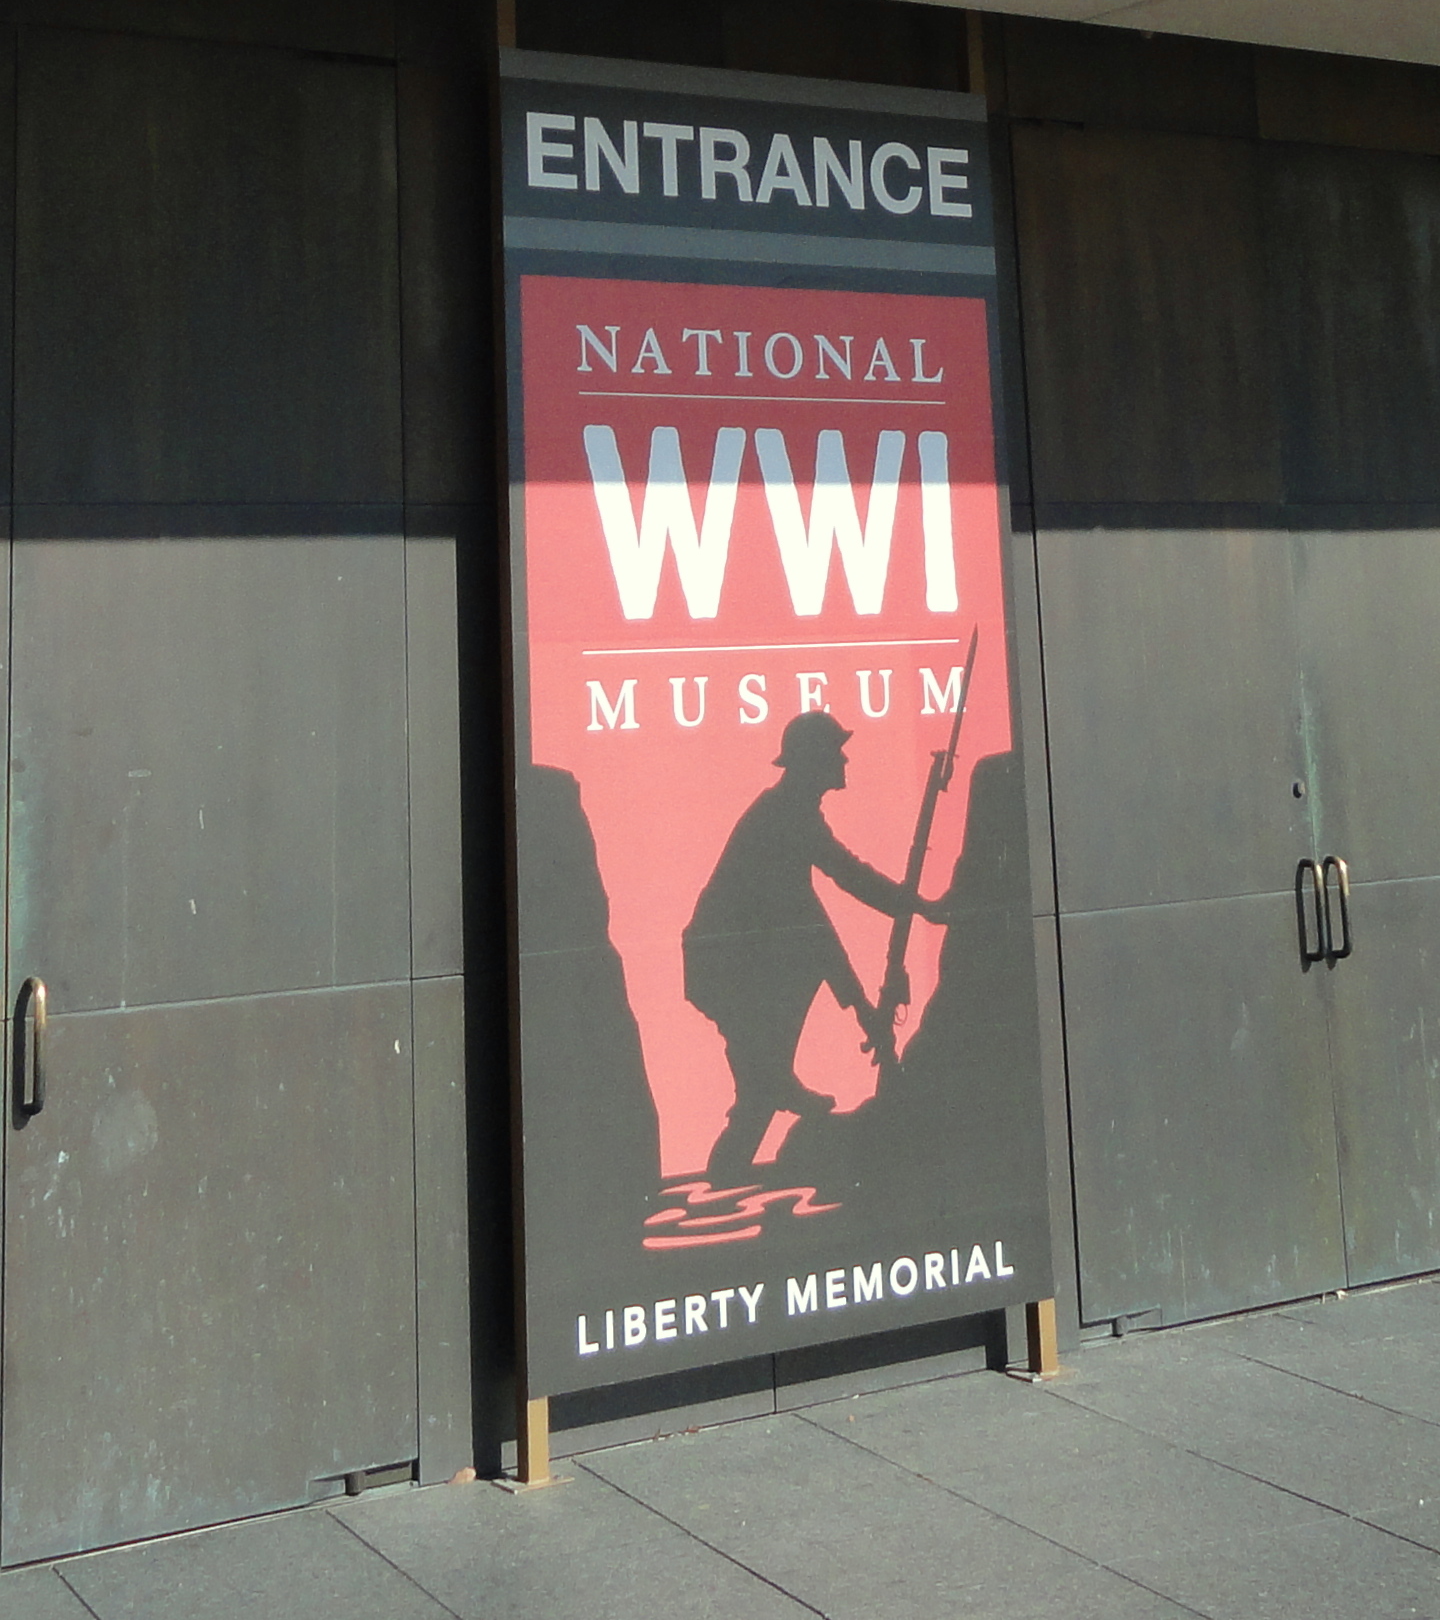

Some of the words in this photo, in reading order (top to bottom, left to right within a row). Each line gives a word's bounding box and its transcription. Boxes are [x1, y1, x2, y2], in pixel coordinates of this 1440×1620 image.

[525, 110, 973, 219] ENTRANCE
[575, 324, 945, 384] NATIONAL
[582, 424, 959, 621] WWI
[585, 665, 967, 732] MUSEUM
[576, 1283, 765, 1356] LIBERTY
[785, 1240, 1015, 1316] MEMORIAL
